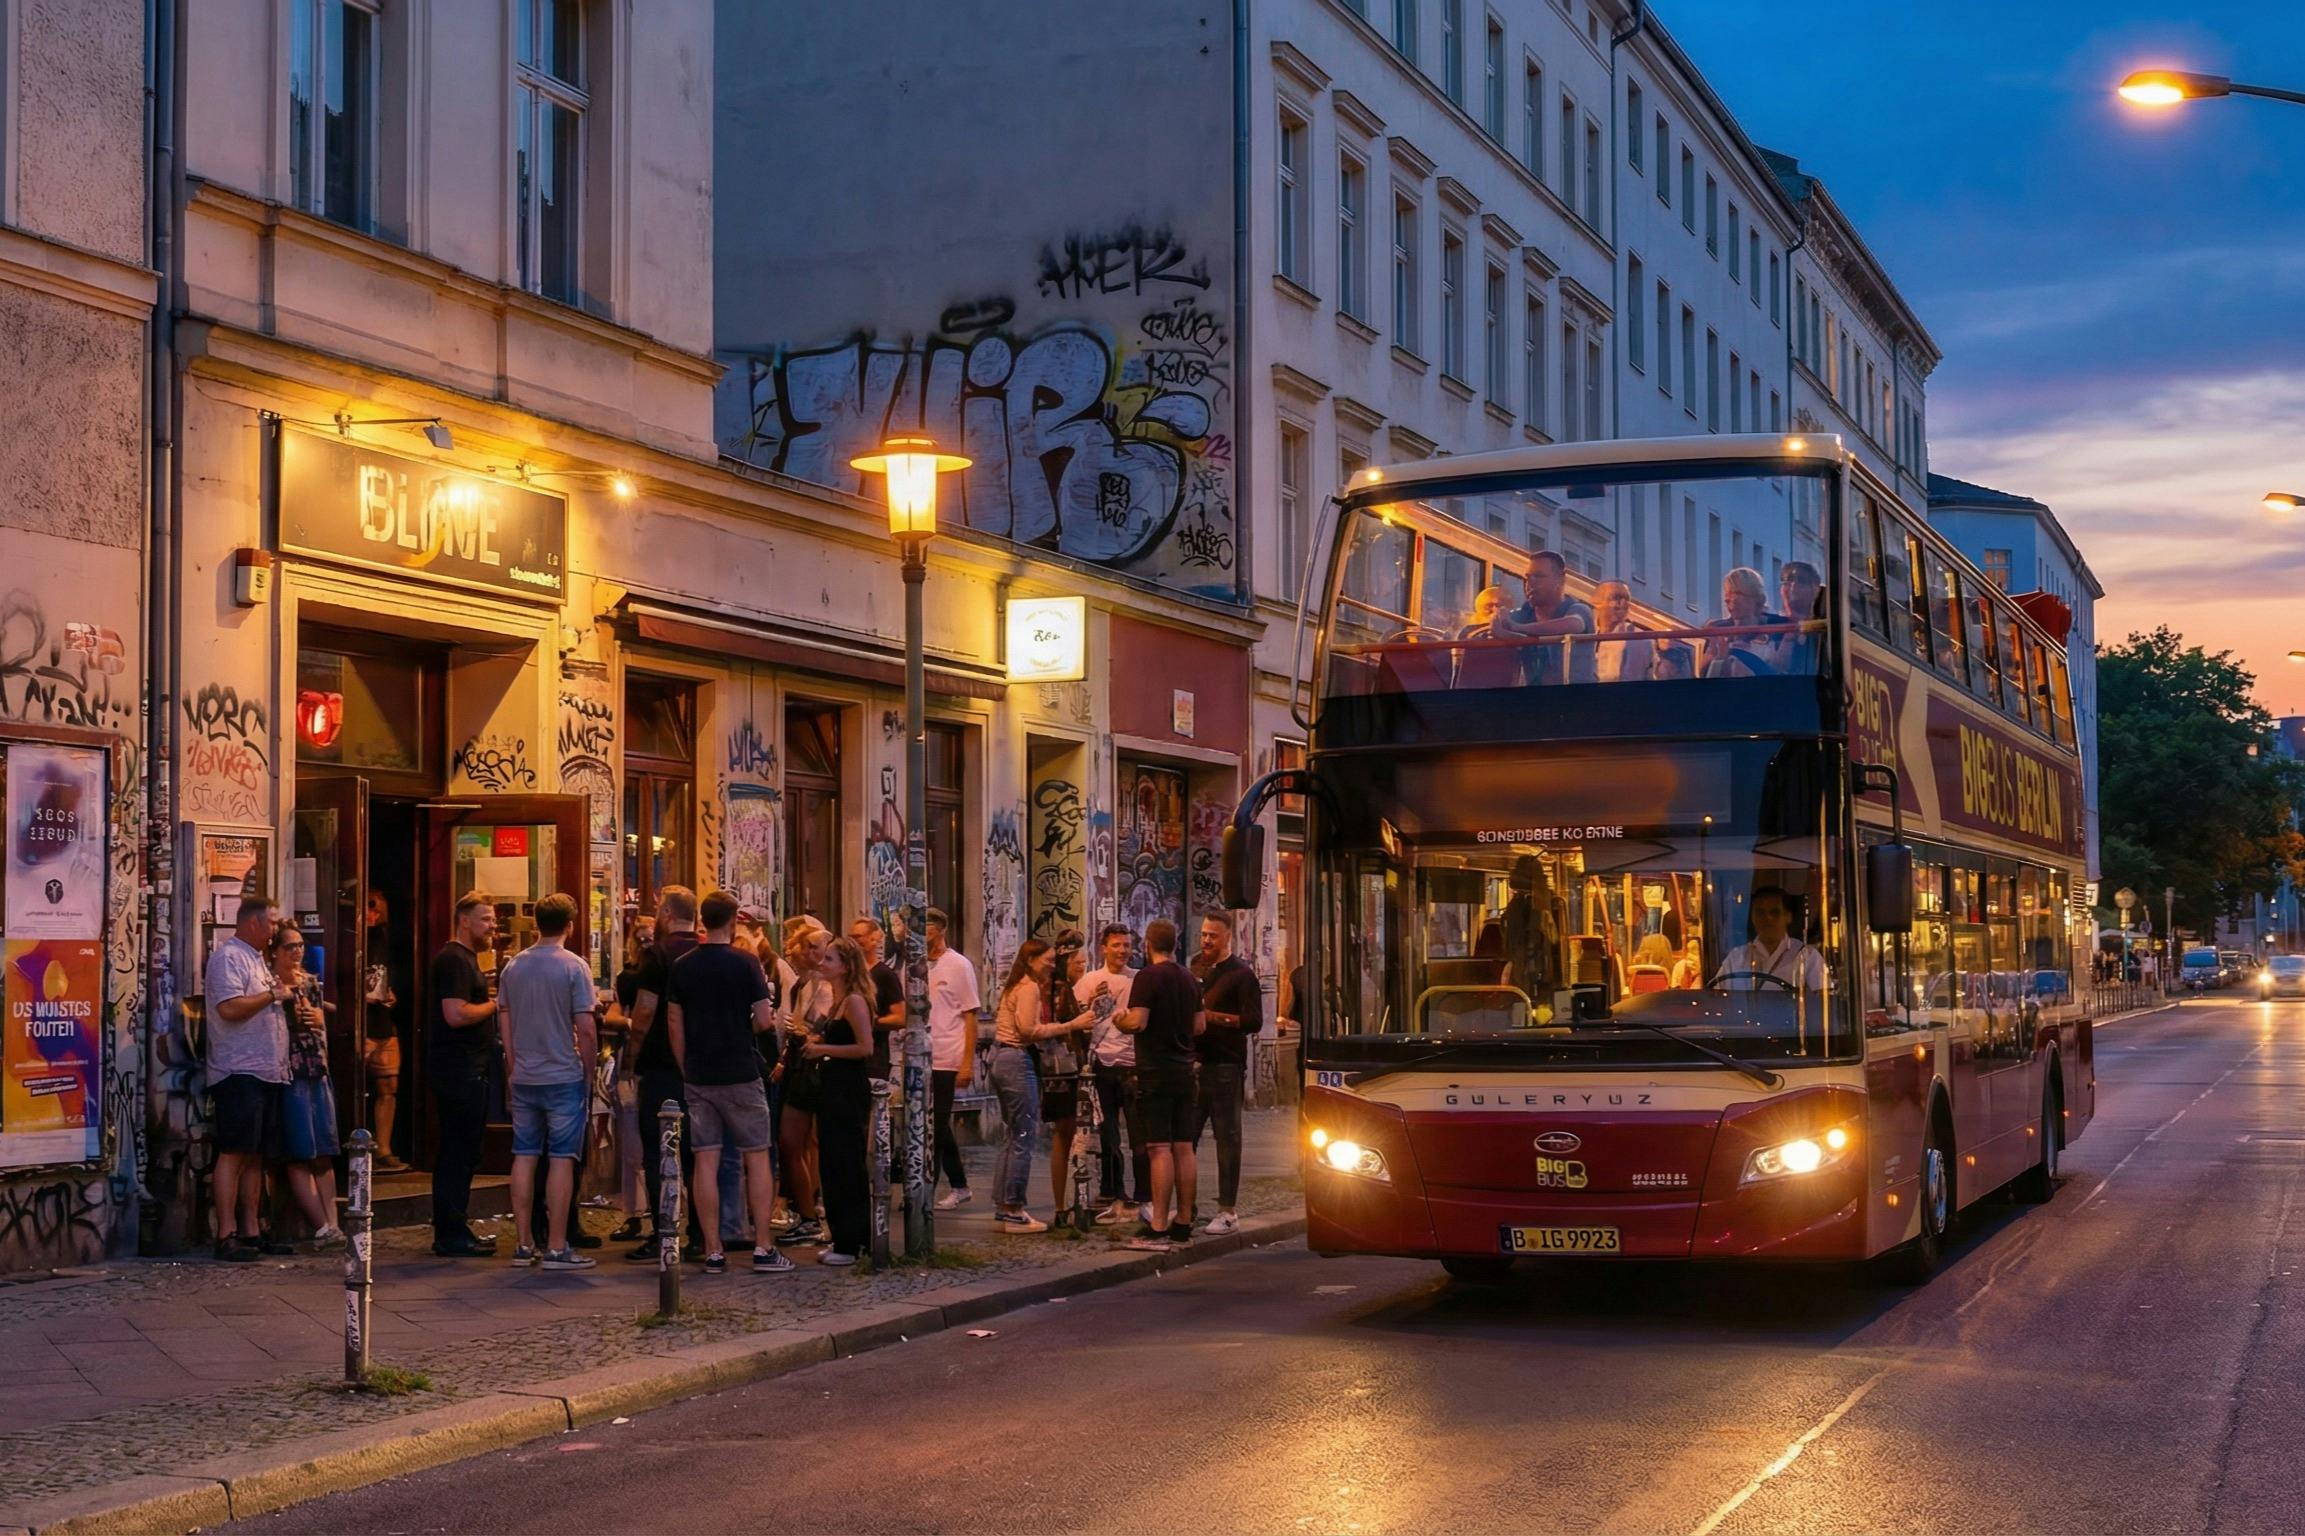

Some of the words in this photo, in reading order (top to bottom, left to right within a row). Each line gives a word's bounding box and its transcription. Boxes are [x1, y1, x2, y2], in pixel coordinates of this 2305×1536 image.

[1536, 1157, 1565, 1173] BIG
[1537, 1173, 1565, 1187] BUS
[1514, 1230, 1526, 1248] B
[1541, 1230, 1564, 1248] IG
[1567, 1230, 1617, 1249] 9923
